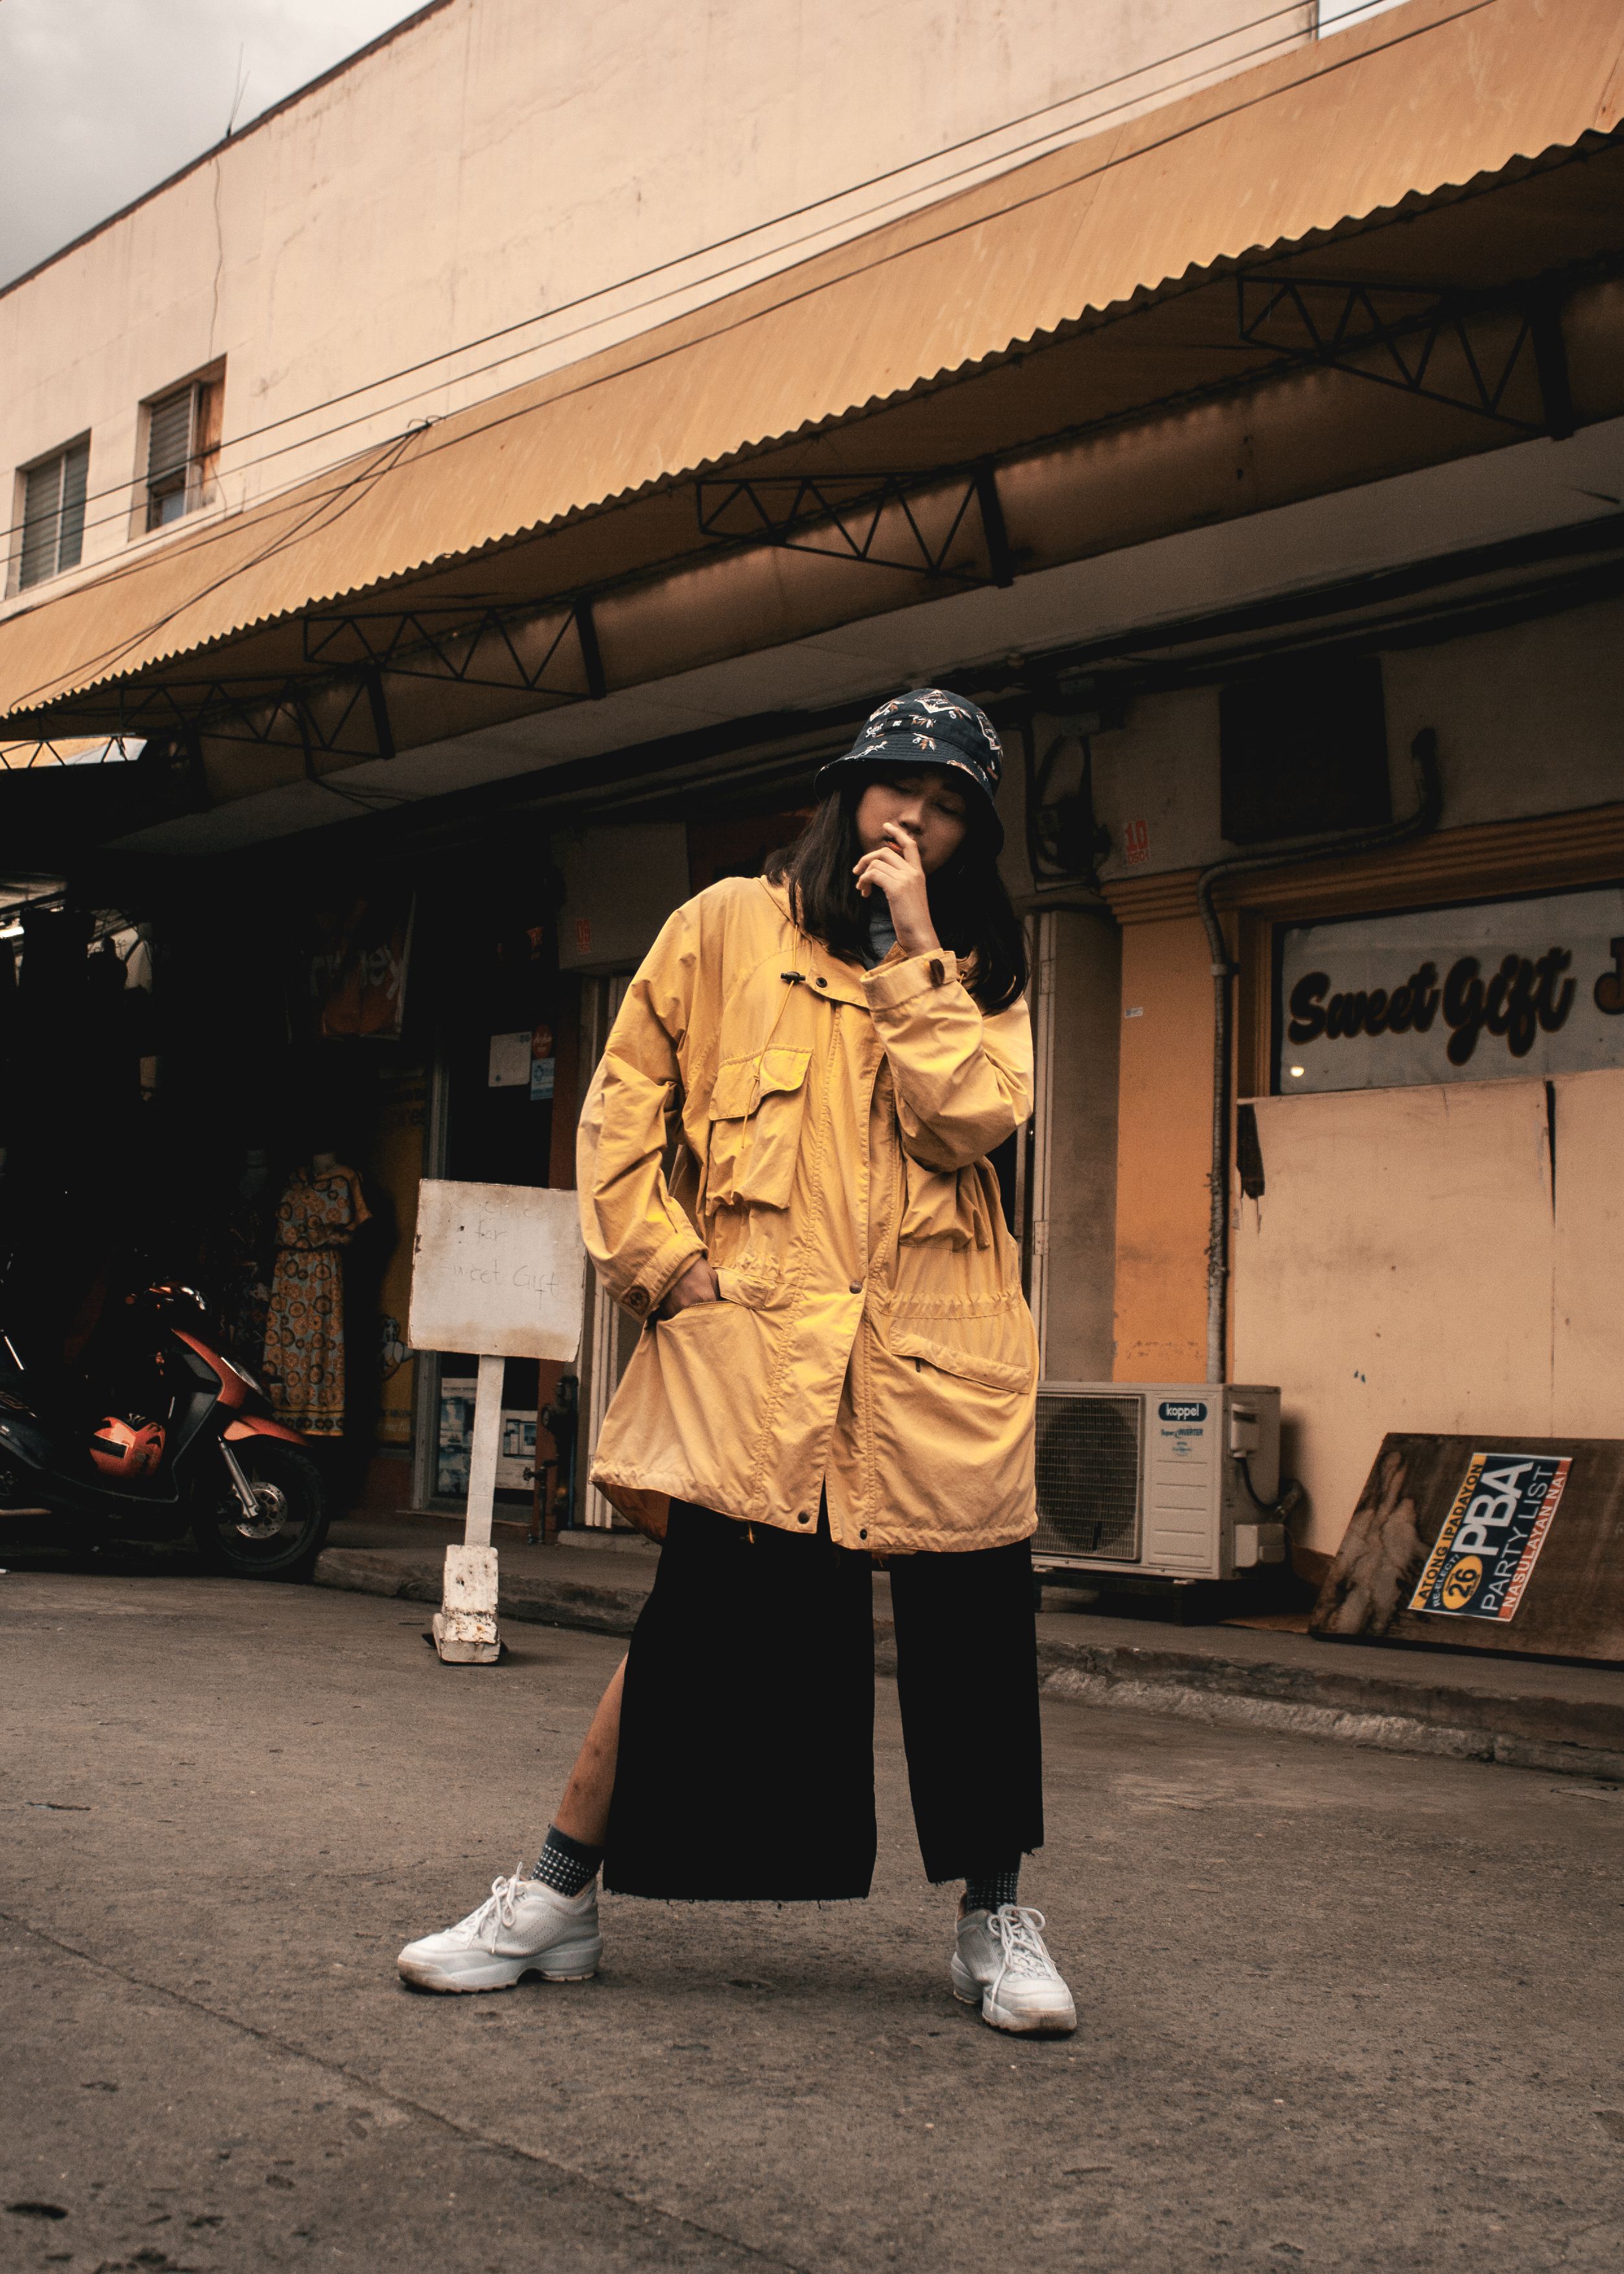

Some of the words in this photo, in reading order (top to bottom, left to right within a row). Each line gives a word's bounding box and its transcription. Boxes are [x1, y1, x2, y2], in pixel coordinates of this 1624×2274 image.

[1125, 820, 1148, 852] 10
[1288, 962, 1442, 1044] Sweet
[1443, 946, 1577, 1066] Gift
[1165, 1403, 1200, 1420] koppel
[1418, 1546, 1448, 1600] ATONG
[1446, 1463, 1483, 1544] IPADAYON
[1452, 1461, 1535, 1555] PBA
[1480, 1526, 1529, 1612] PARTY
[1518, 1465, 1553, 1520] LIST
[1502, 1505, 1554, 1607] NASULAYAN
[1448, 1568, 1477, 1599] 26
